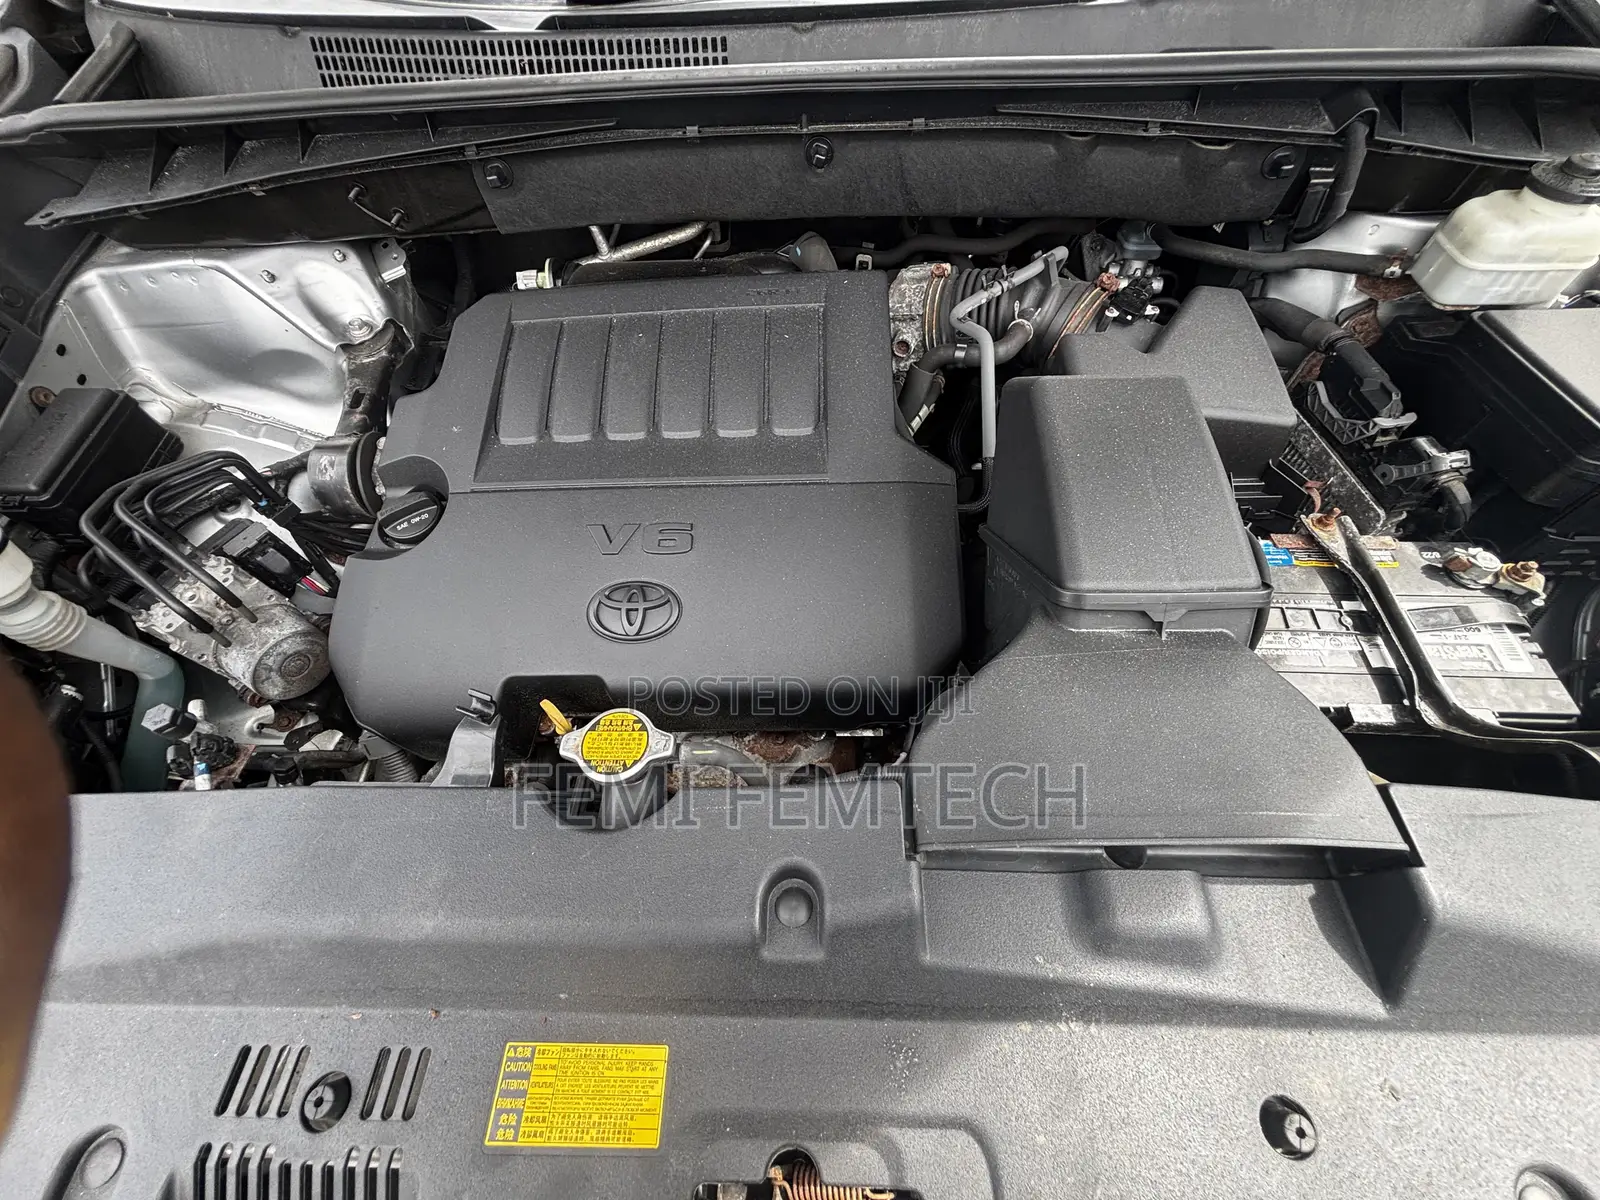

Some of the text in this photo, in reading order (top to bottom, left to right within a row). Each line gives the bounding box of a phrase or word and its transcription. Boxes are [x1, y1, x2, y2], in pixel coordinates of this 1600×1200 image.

[396, 513, 429, 531] SAE 0W-20
[586, 522, 693, 555] V6
[1423, 644, 1492, 661] EverSta
[505, 1061, 532, 1072] CAUTION
[500, 1079, 528, 1090] ATTENTION
